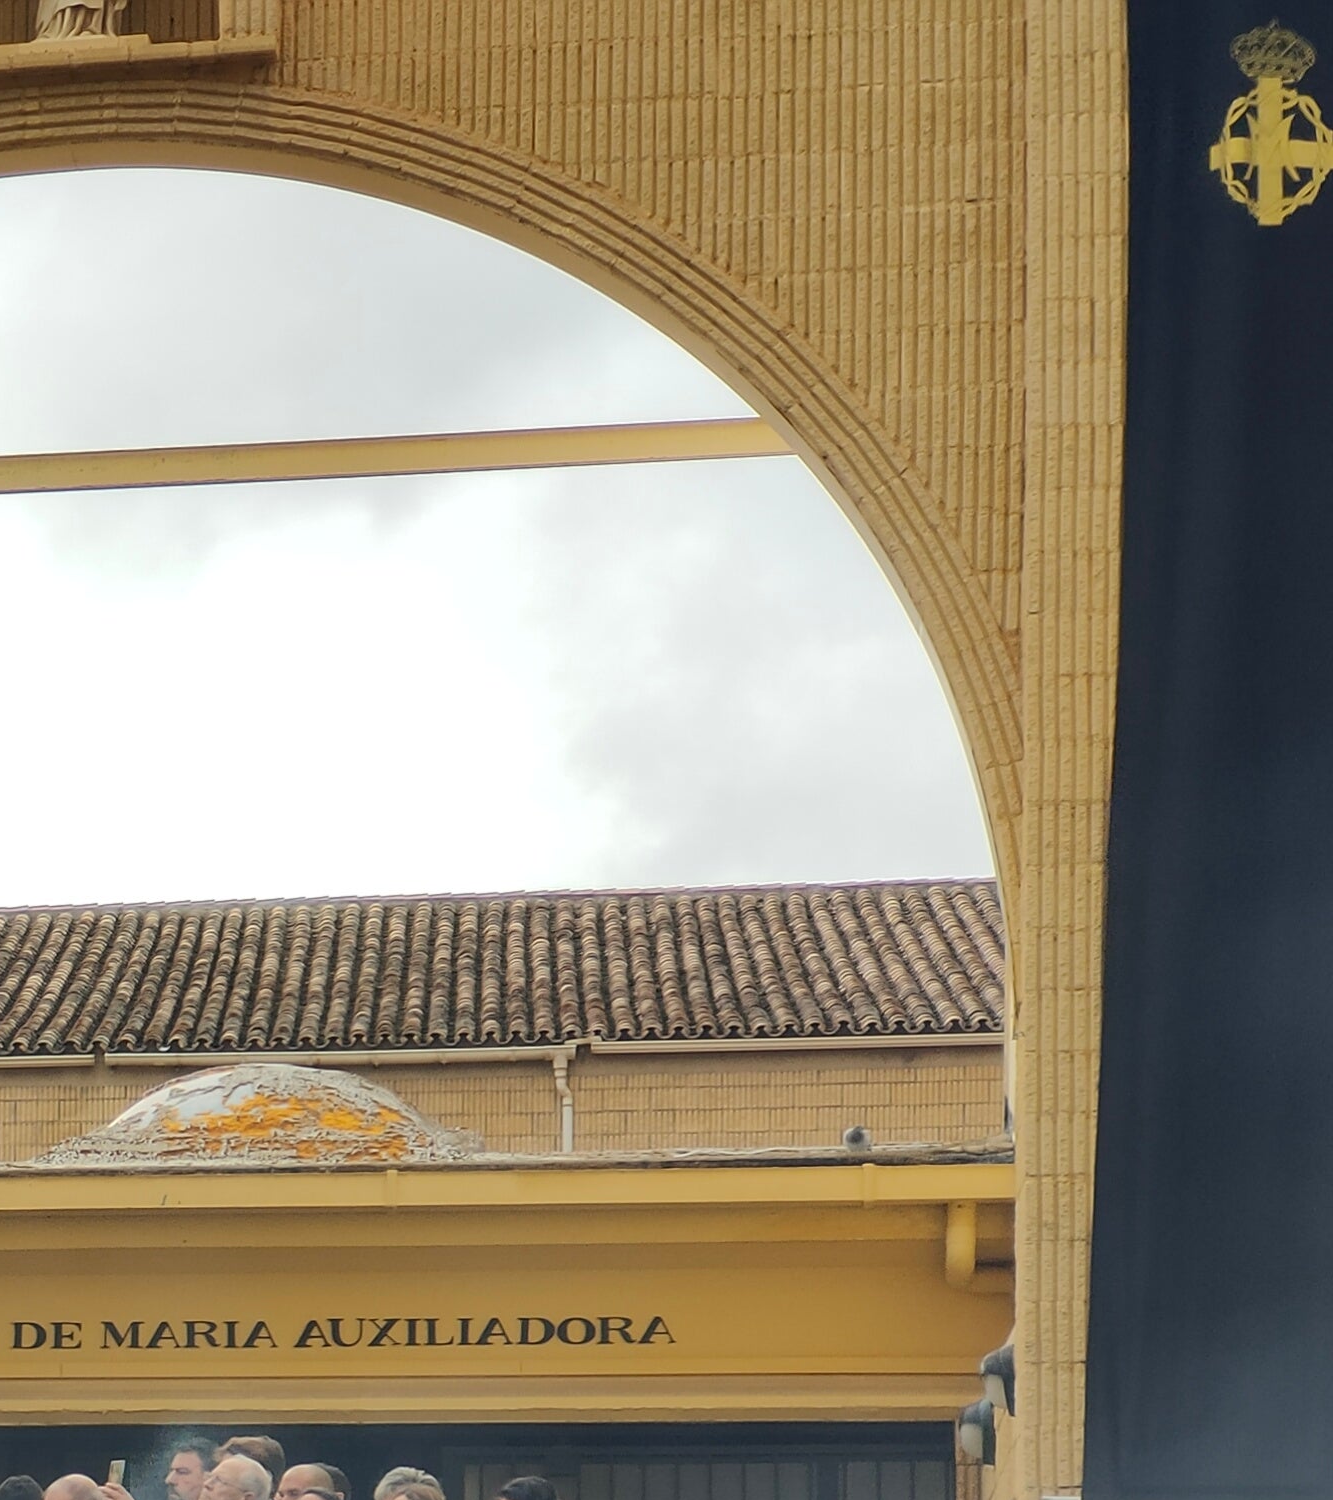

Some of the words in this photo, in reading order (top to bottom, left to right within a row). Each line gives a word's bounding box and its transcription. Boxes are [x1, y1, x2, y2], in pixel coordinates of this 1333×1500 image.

[11, 1321, 83, 1349] DE
[99, 1320, 278, 1349] MARIA
[293, 1315, 677, 1348] AUXILIADORA
